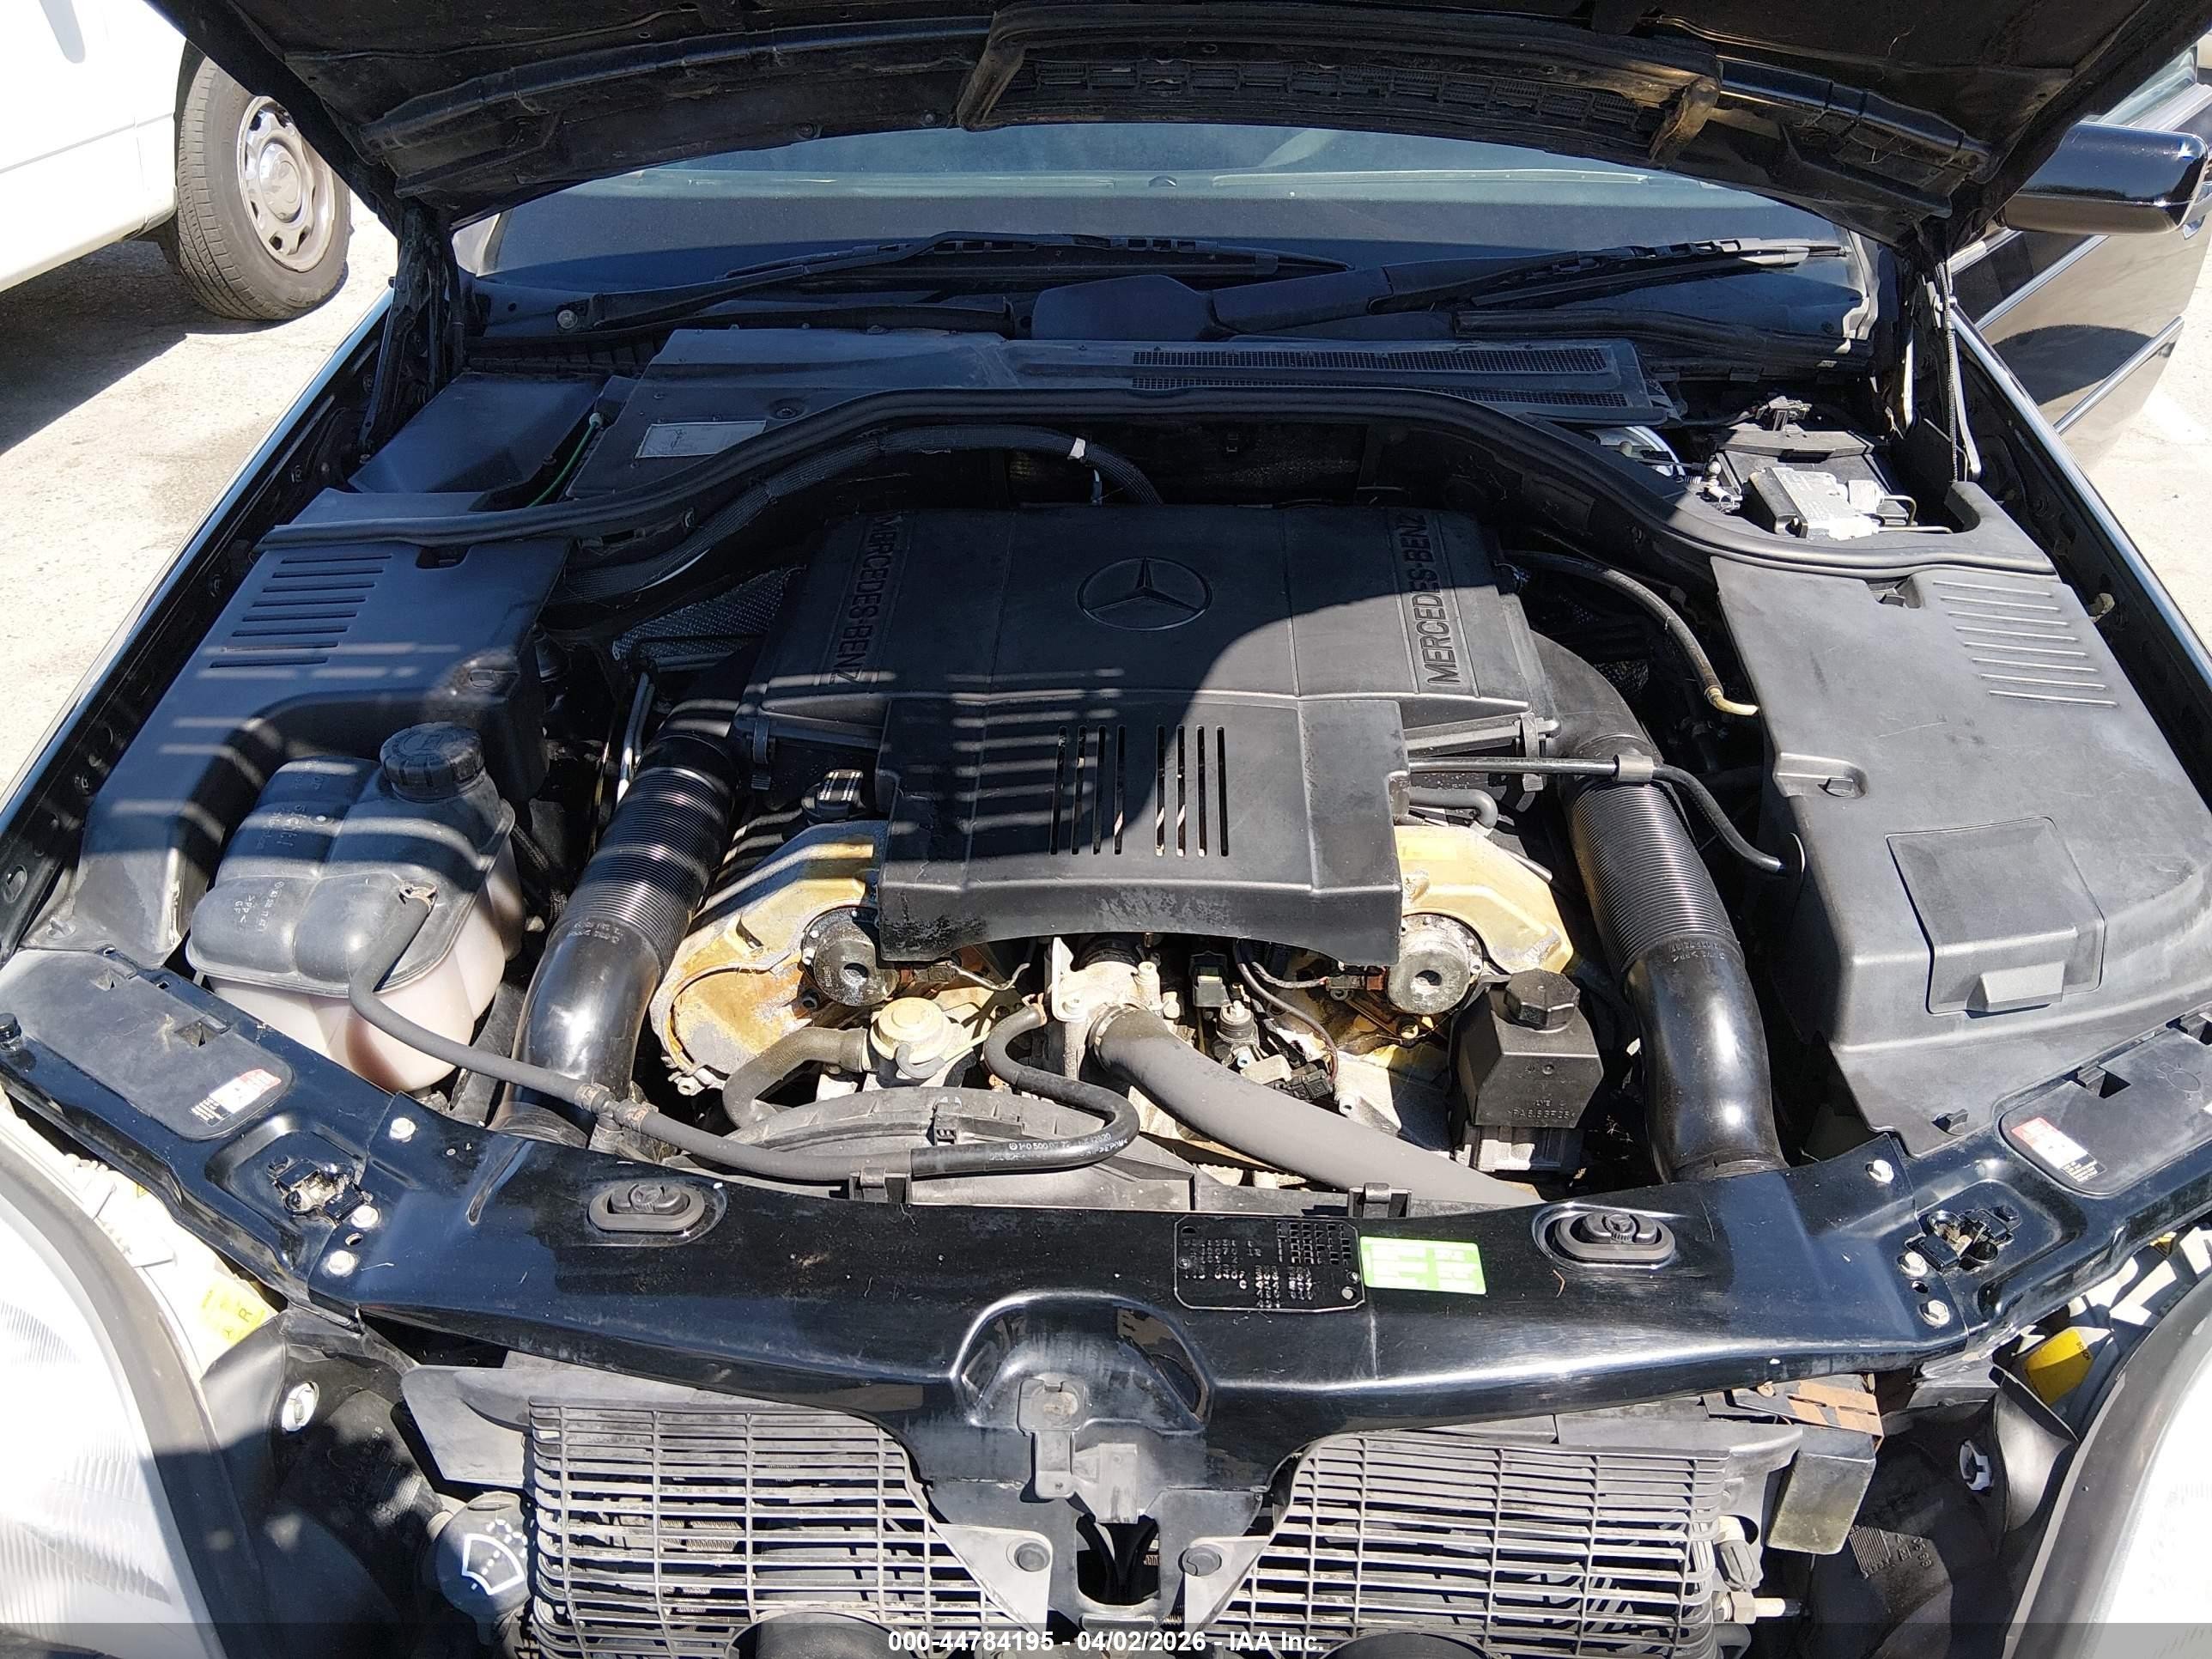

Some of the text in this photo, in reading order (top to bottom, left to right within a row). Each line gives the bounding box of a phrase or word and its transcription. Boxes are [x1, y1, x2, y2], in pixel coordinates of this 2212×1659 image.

[833, 512, 901, 683] MERCEDES-BENZ
[1395, 514, 1461, 684] MERCEDES-BENZ
[238, 1308, 253, 1323] R
